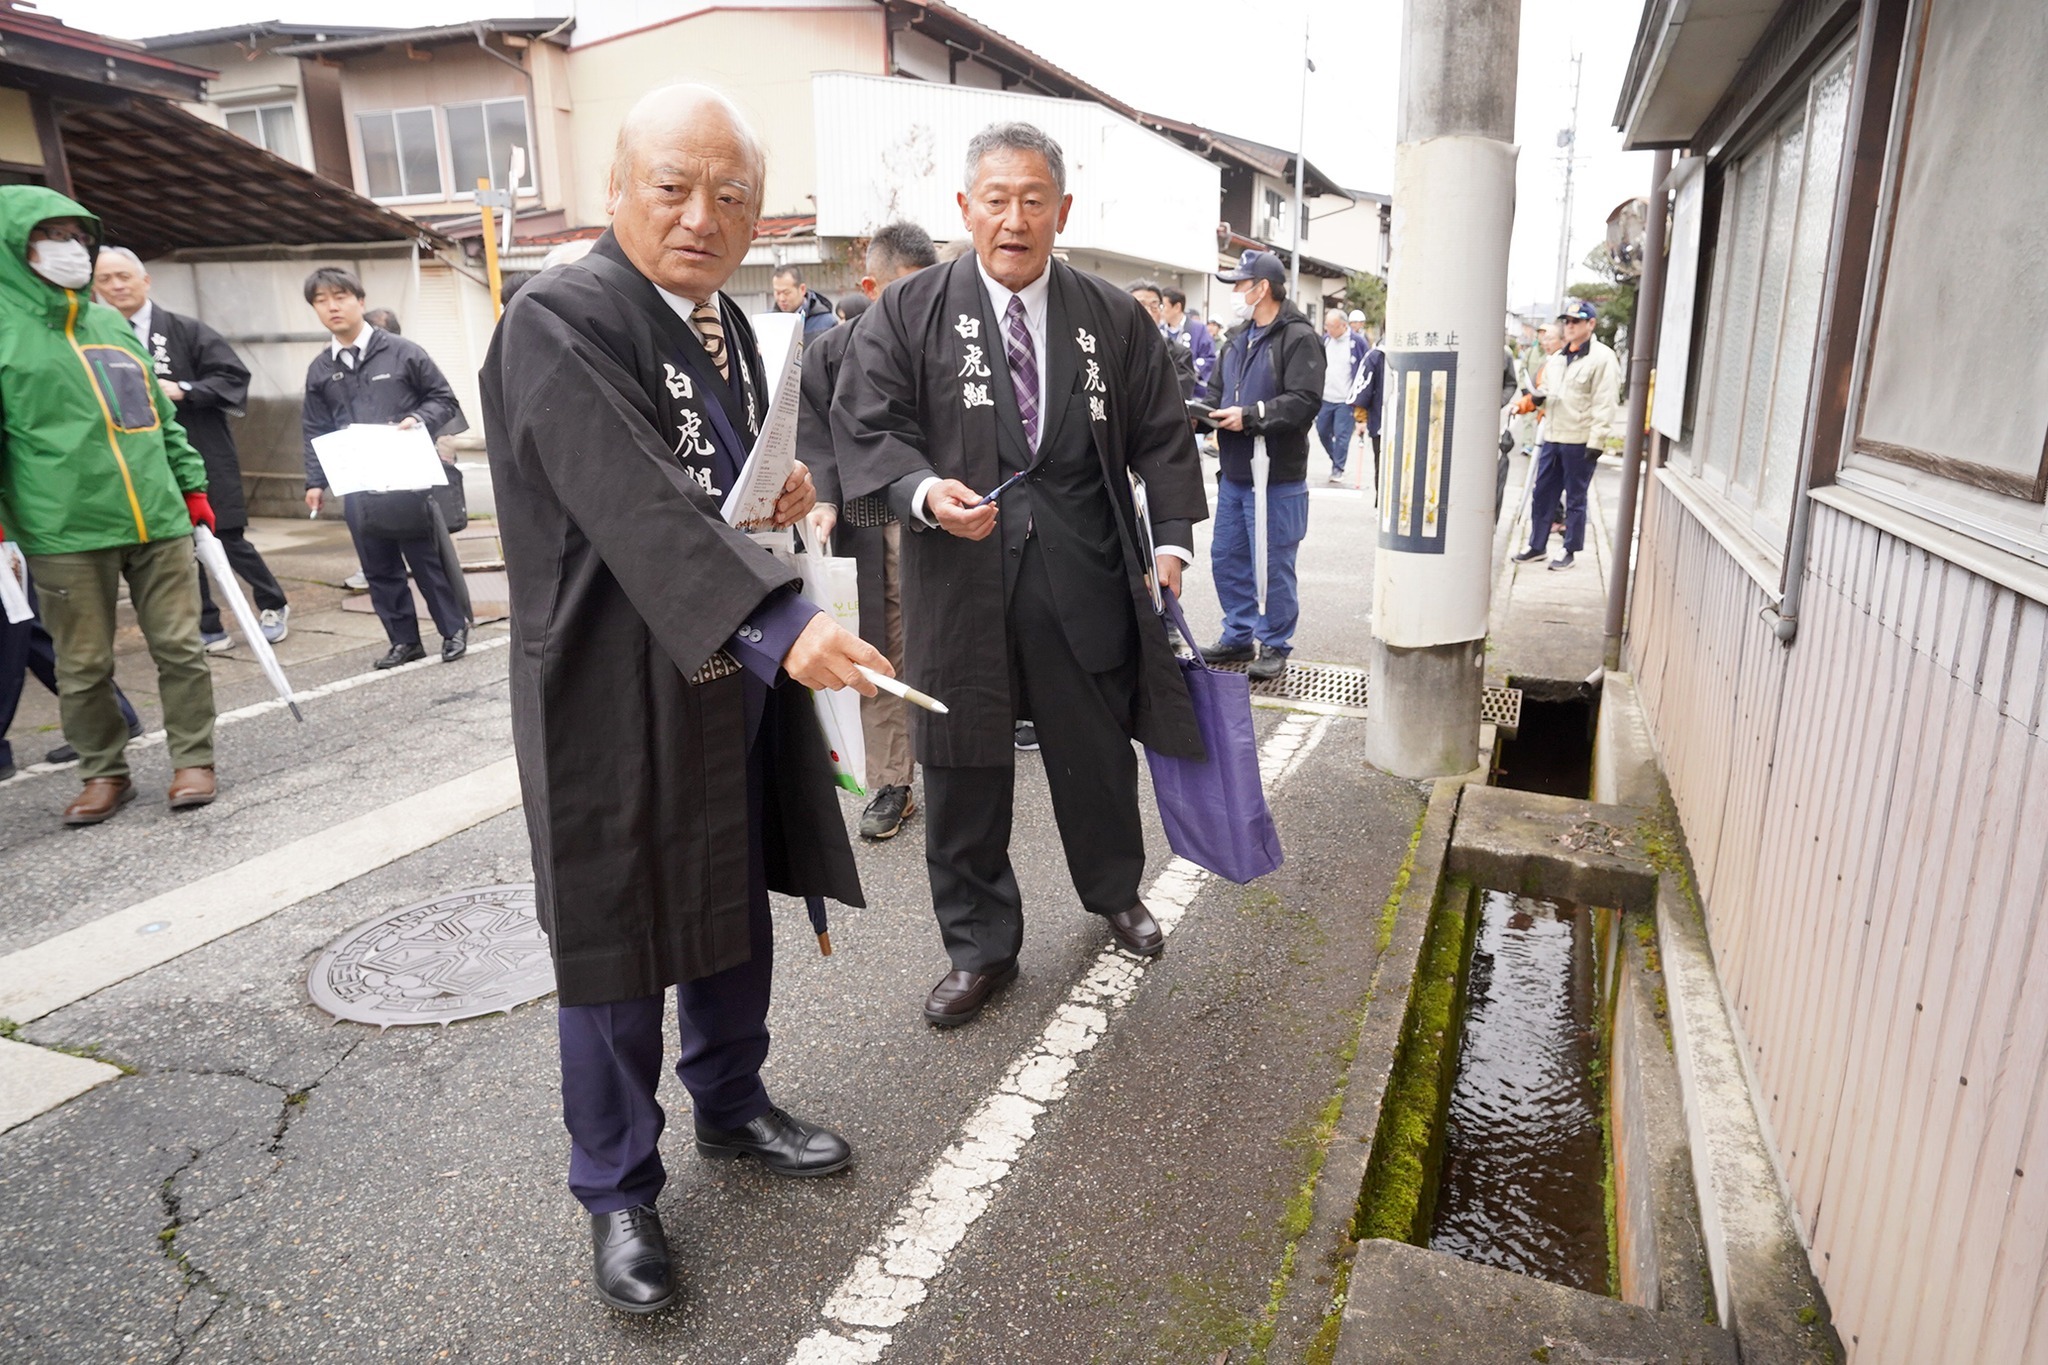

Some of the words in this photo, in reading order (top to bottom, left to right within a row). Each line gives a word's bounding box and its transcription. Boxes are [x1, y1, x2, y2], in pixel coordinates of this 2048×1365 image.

[954, 314, 995, 409] 白虎組
[1075, 327, 1108, 422] 白虎組
